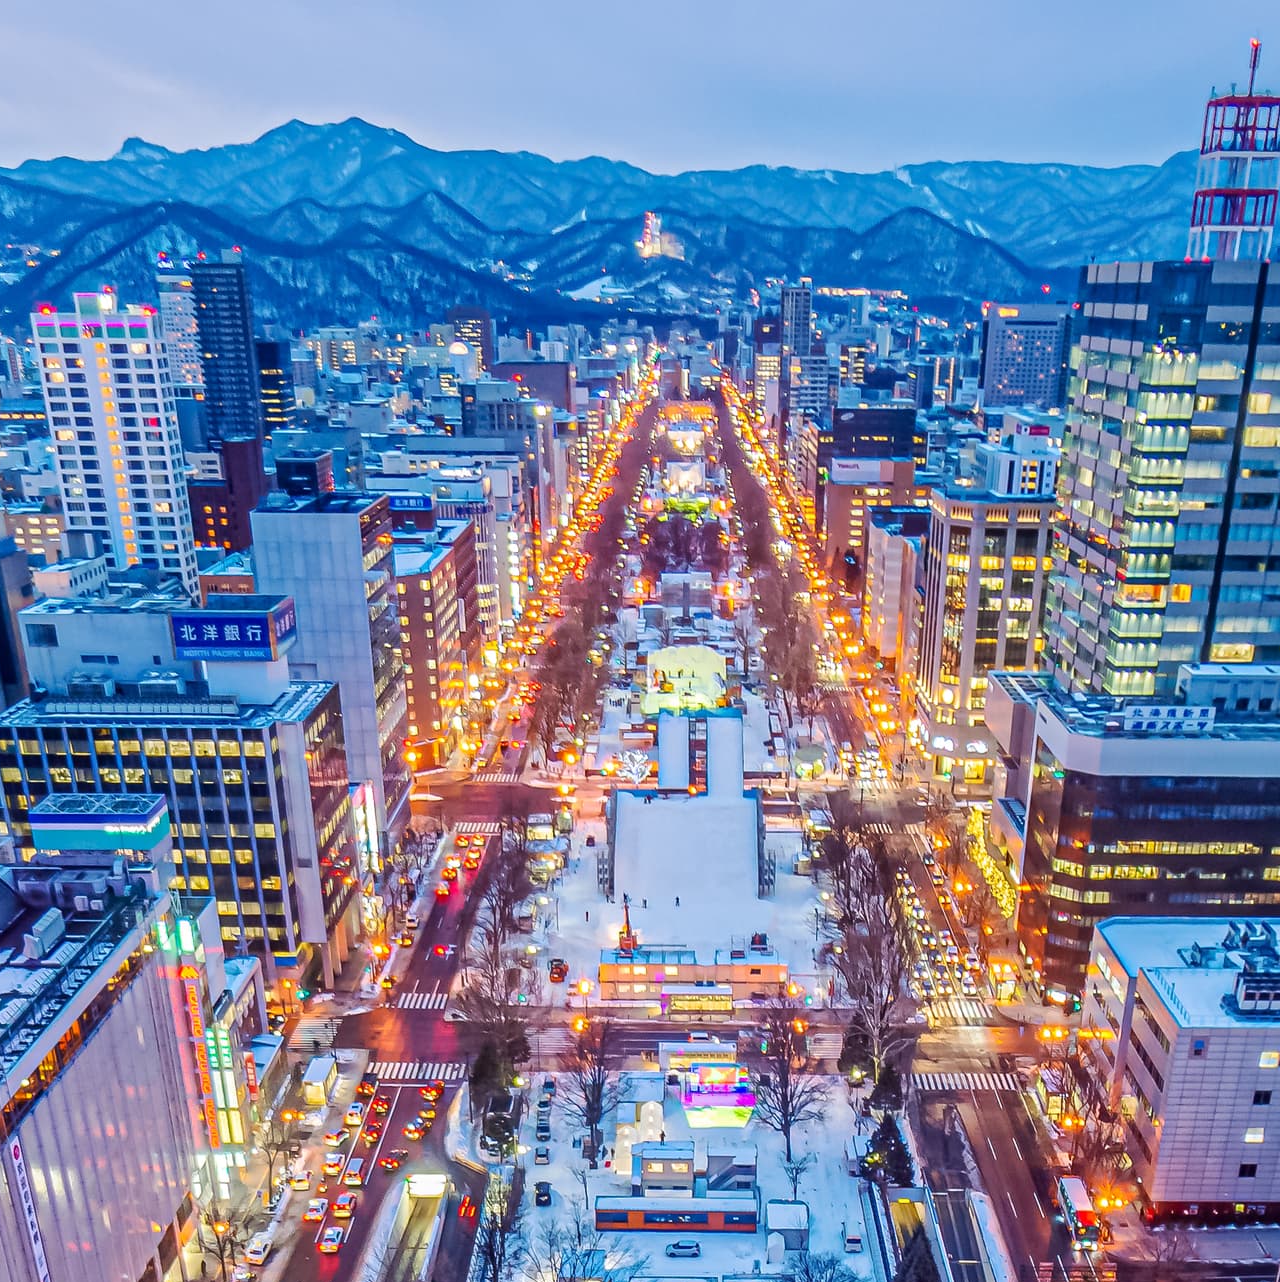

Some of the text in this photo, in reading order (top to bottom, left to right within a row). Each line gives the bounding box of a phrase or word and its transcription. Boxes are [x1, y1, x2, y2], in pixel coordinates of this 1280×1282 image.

[180, 624, 262, 641] 北洋銀行
[183, 650, 210, 658] NORTH
